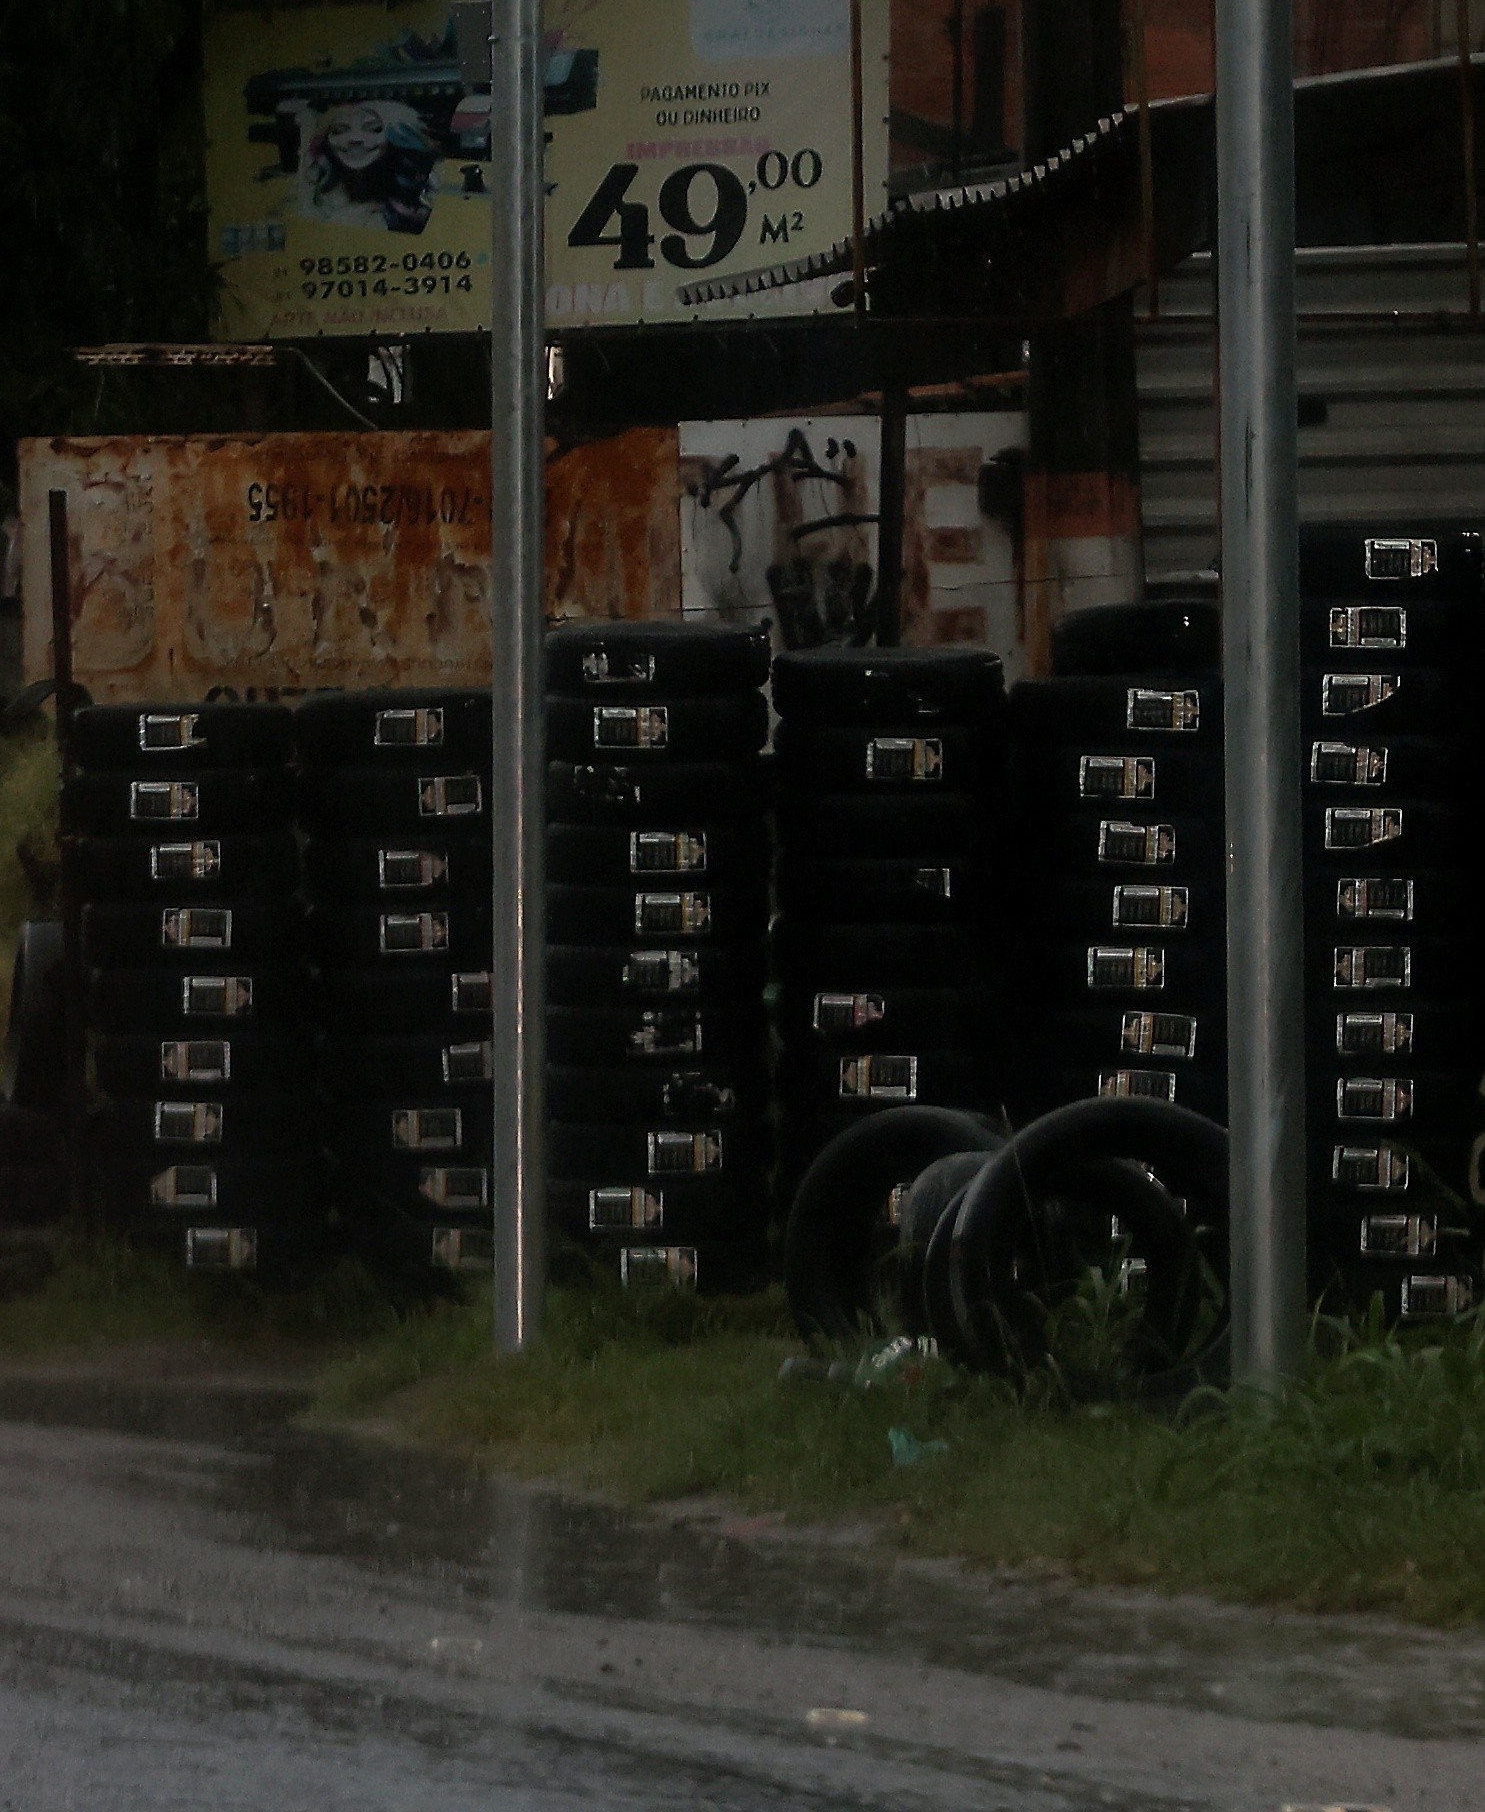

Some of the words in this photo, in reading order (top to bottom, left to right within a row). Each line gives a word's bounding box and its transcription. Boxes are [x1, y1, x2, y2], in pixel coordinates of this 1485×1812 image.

[640, 83, 740, 102] PAGAMENTO
[744, 81, 771, 97] PIX
[655, 110, 678, 126] OU
[683, 106, 761, 125] DINHEIRO
[299, 250, 472, 276] 98582-0406
[301, 273, 473, 300] 97014-3914
